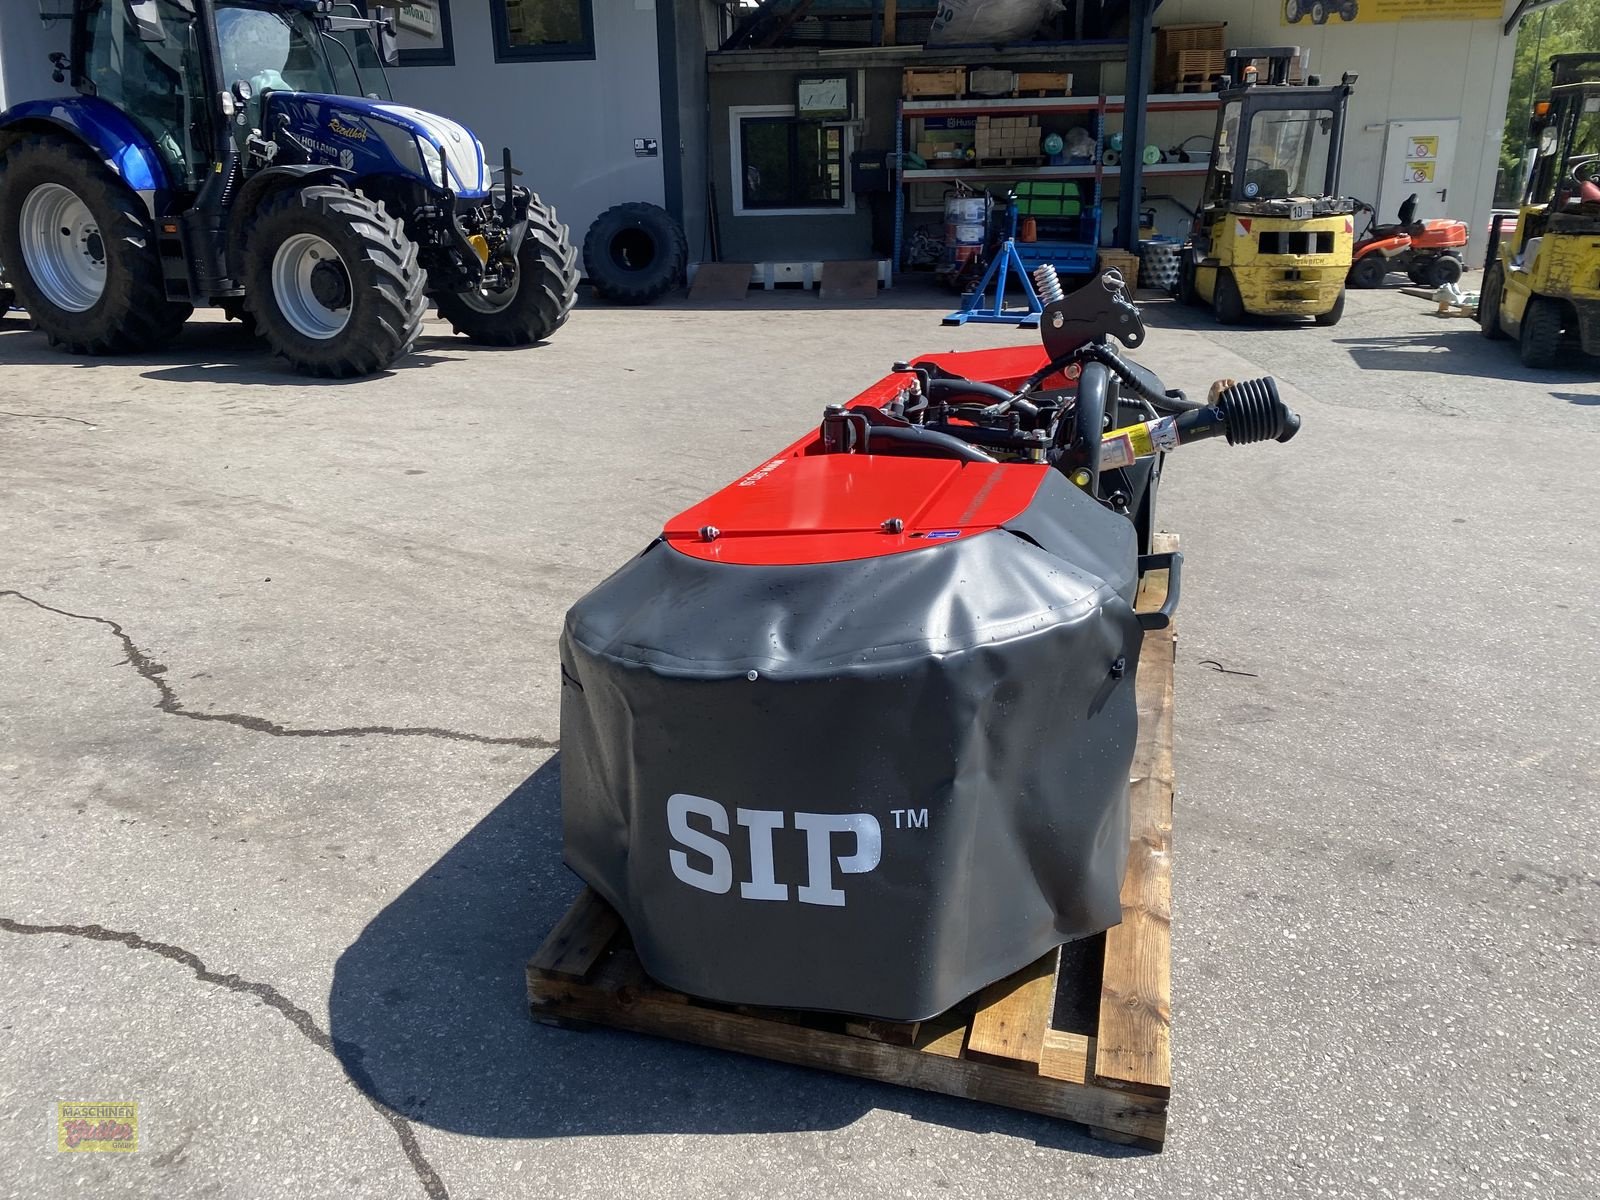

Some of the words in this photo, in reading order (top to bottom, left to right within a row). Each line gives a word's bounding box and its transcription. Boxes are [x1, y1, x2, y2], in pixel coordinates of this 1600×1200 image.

[301, 136, 338, 158] HOLLAND
[666, 793, 882, 907] SIP
[889, 808, 930, 829] TM
